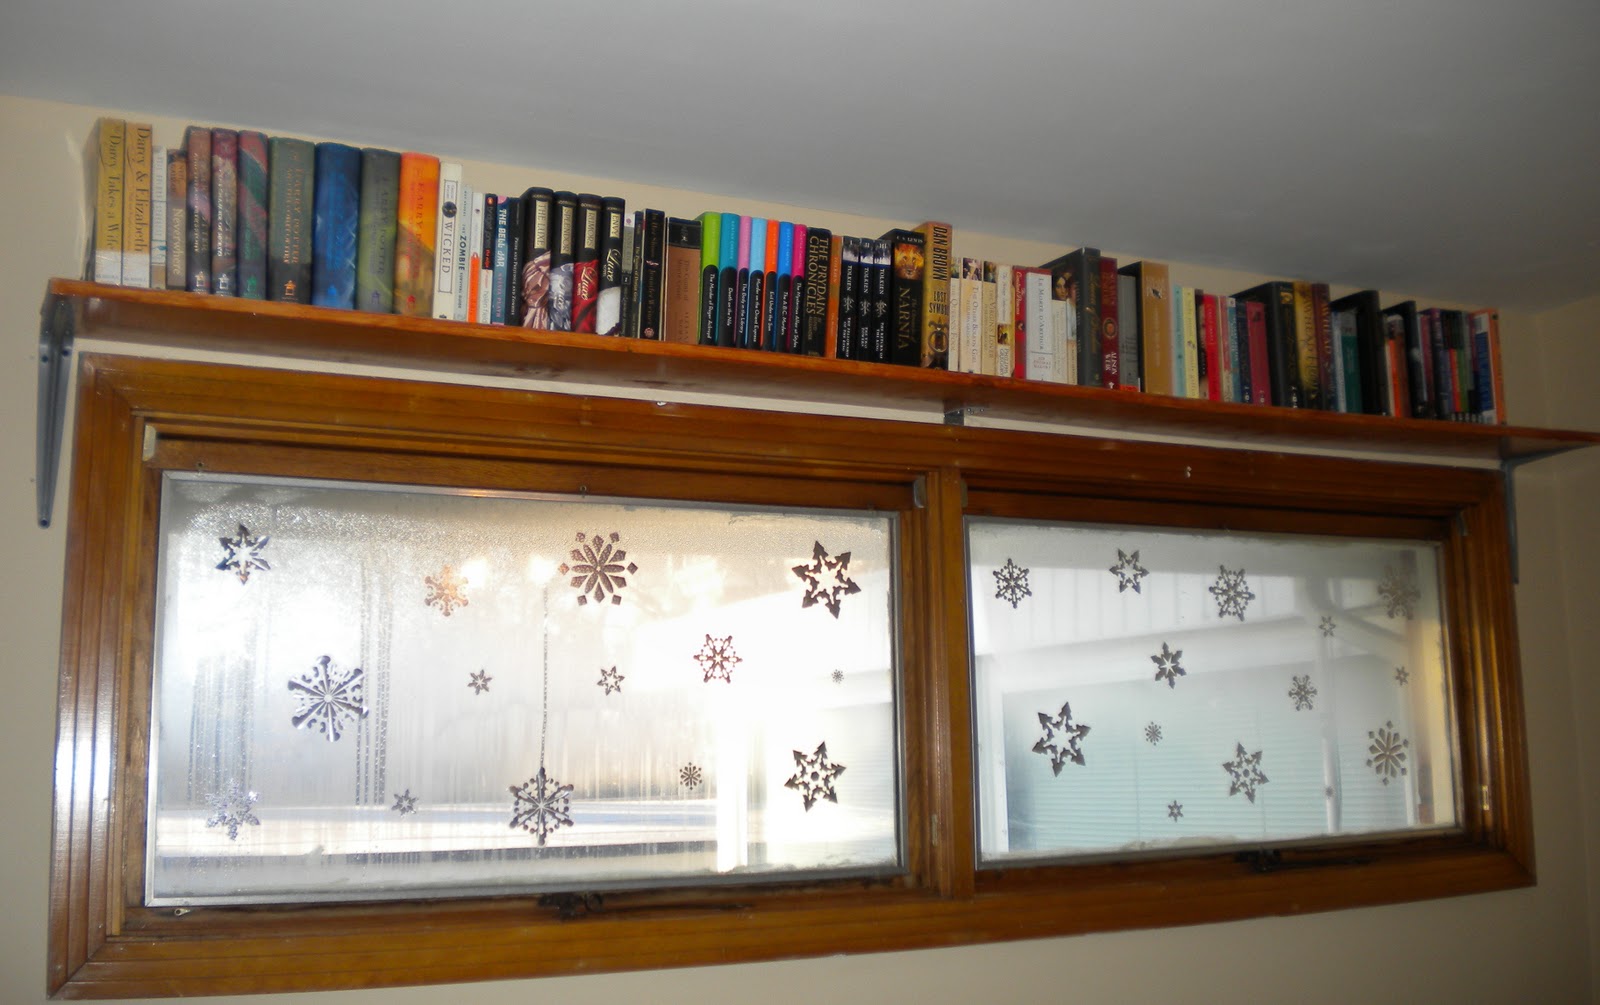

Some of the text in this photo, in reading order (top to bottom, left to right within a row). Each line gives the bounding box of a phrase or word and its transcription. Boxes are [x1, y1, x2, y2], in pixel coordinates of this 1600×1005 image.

[108, 135, 121, 168] Darcy
[108, 175, 120, 208] Takes
[134, 127, 150, 252] Darcy & Elizabeth
[538, 204, 546, 221] THE
[586, 212, 596, 247] RUMORS
[612, 215, 620, 236] ENVY
[107, 223, 119, 250] Wife
[172, 208, 183, 275] Neverwhere
[442, 222, 453, 273] WICKED
[496, 208, 507, 267] THE BELL JAR
[537, 223, 546, 246] LUXE
[562, 209, 572, 252] SPLENDOR
[458, 235, 467, 270] ZOMBIE
[606, 248, 622, 282] Luxe
[933, 226, 948, 281] DAN BROWN
[580, 267, 597, 300] Luxe
[806, 236, 819, 314] CHRONICLES
[816, 238, 828, 316] THE PRYDAIN
[933, 290, 947, 302] LOST
[898, 287, 911, 350] NARNIA
